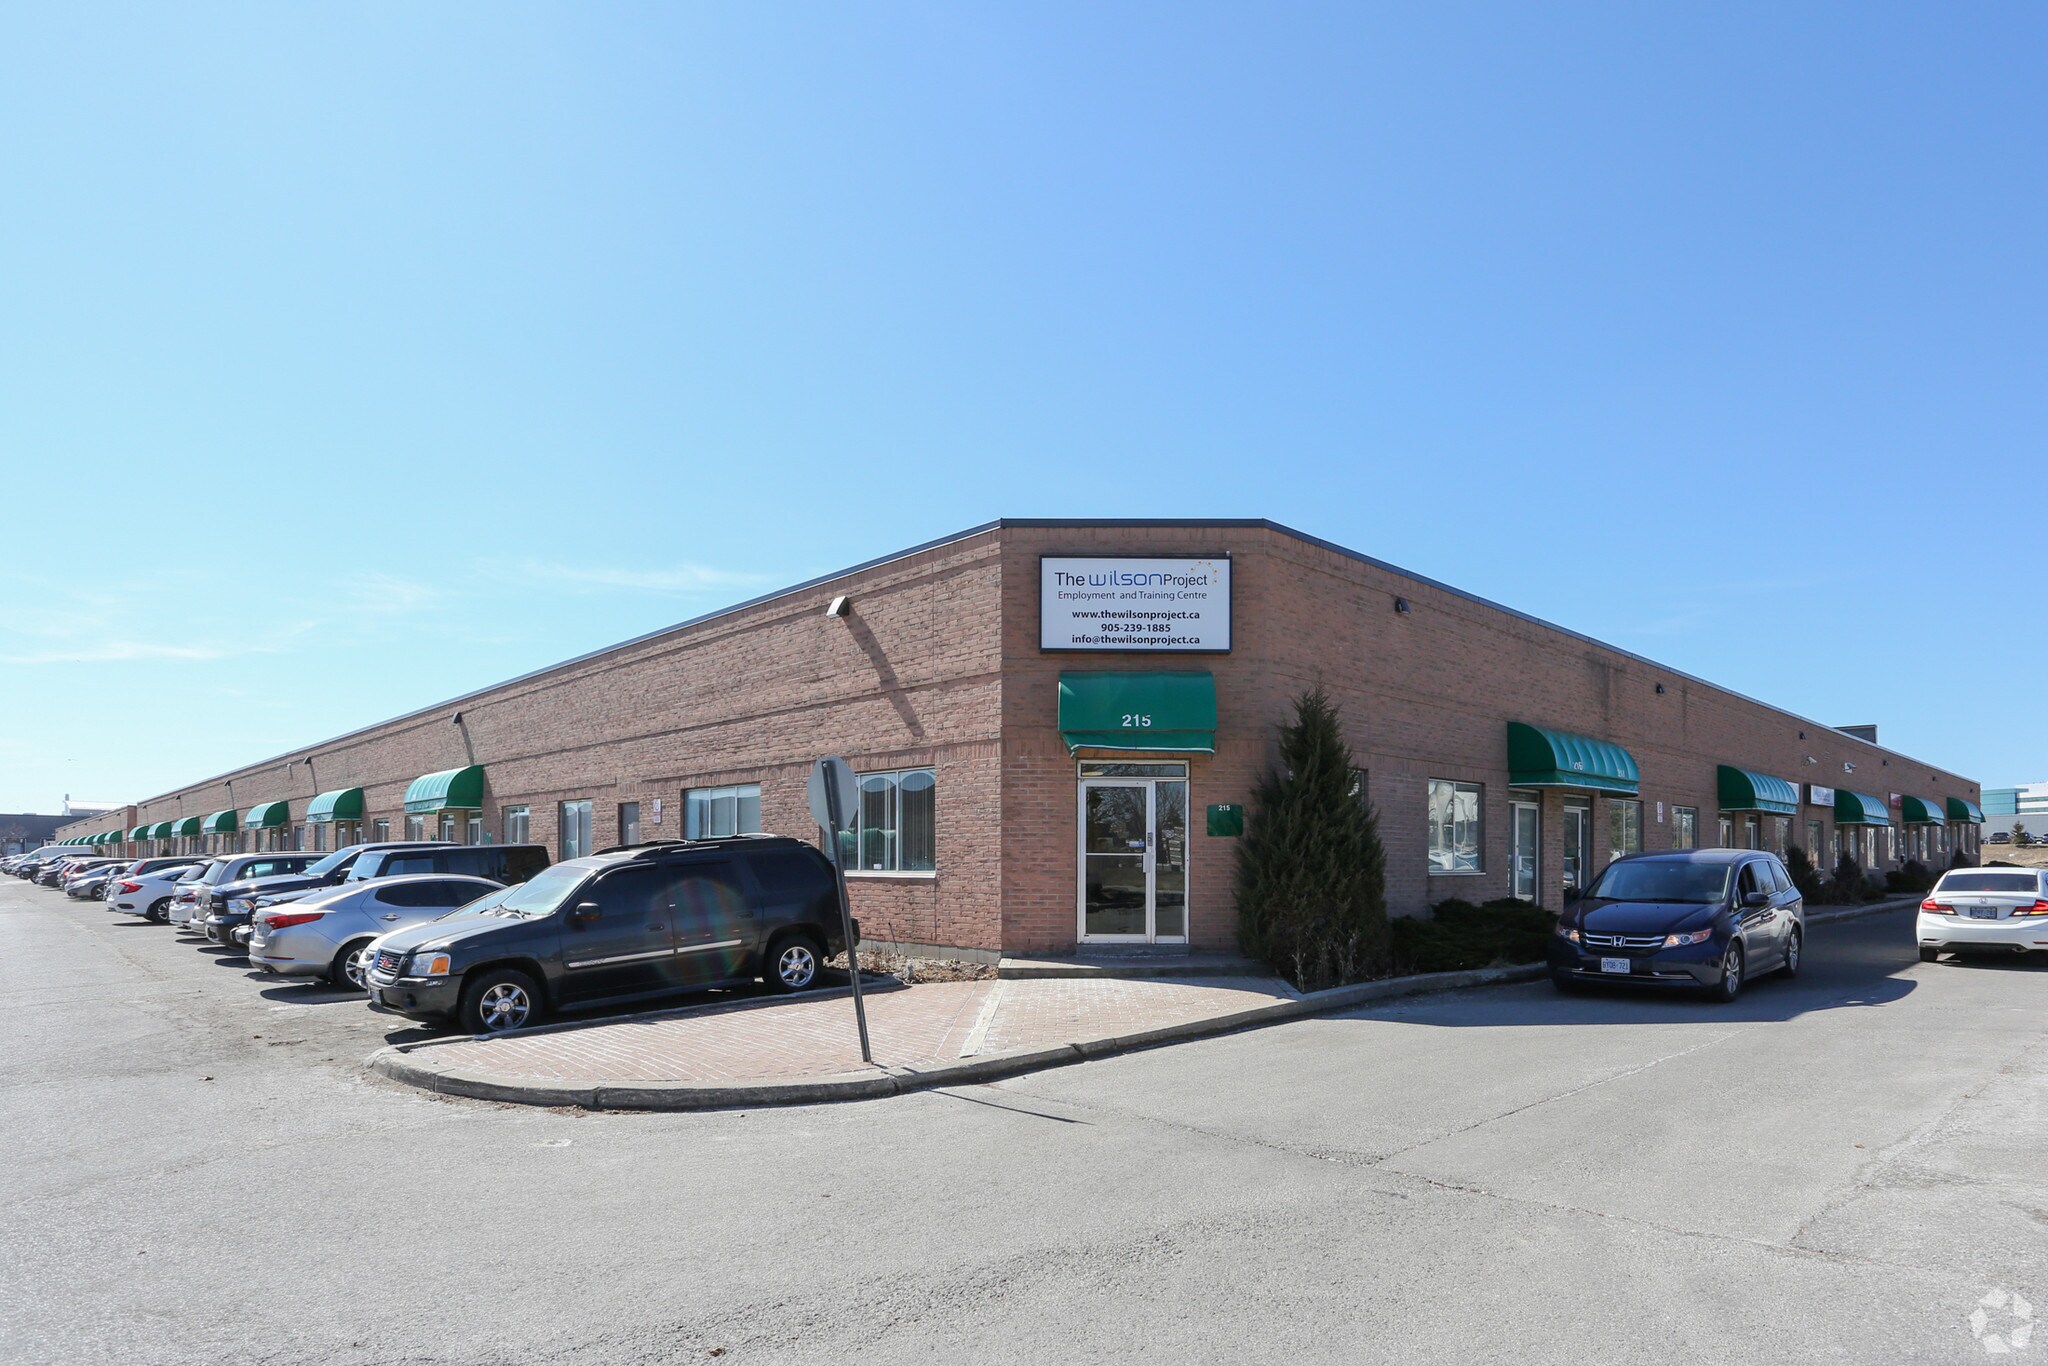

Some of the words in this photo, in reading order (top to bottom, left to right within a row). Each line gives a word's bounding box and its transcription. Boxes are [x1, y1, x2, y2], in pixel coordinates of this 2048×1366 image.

[1054, 571, 1086, 587] The
[1058, 590, 1116, 602] Employment
[1119, 590, 1137, 600] and
[1138, 590, 1175, 602] Training
[1176, 590, 1208, 600] Centre
[1071, 609, 1200, 621] www.thewilsonproject.ca
[1100, 623, 1171, 633] 905-239-1885
[1071, 635, 1200, 645] info@thewilsonproject.ca
[1121, 714, 1152, 727] 215
